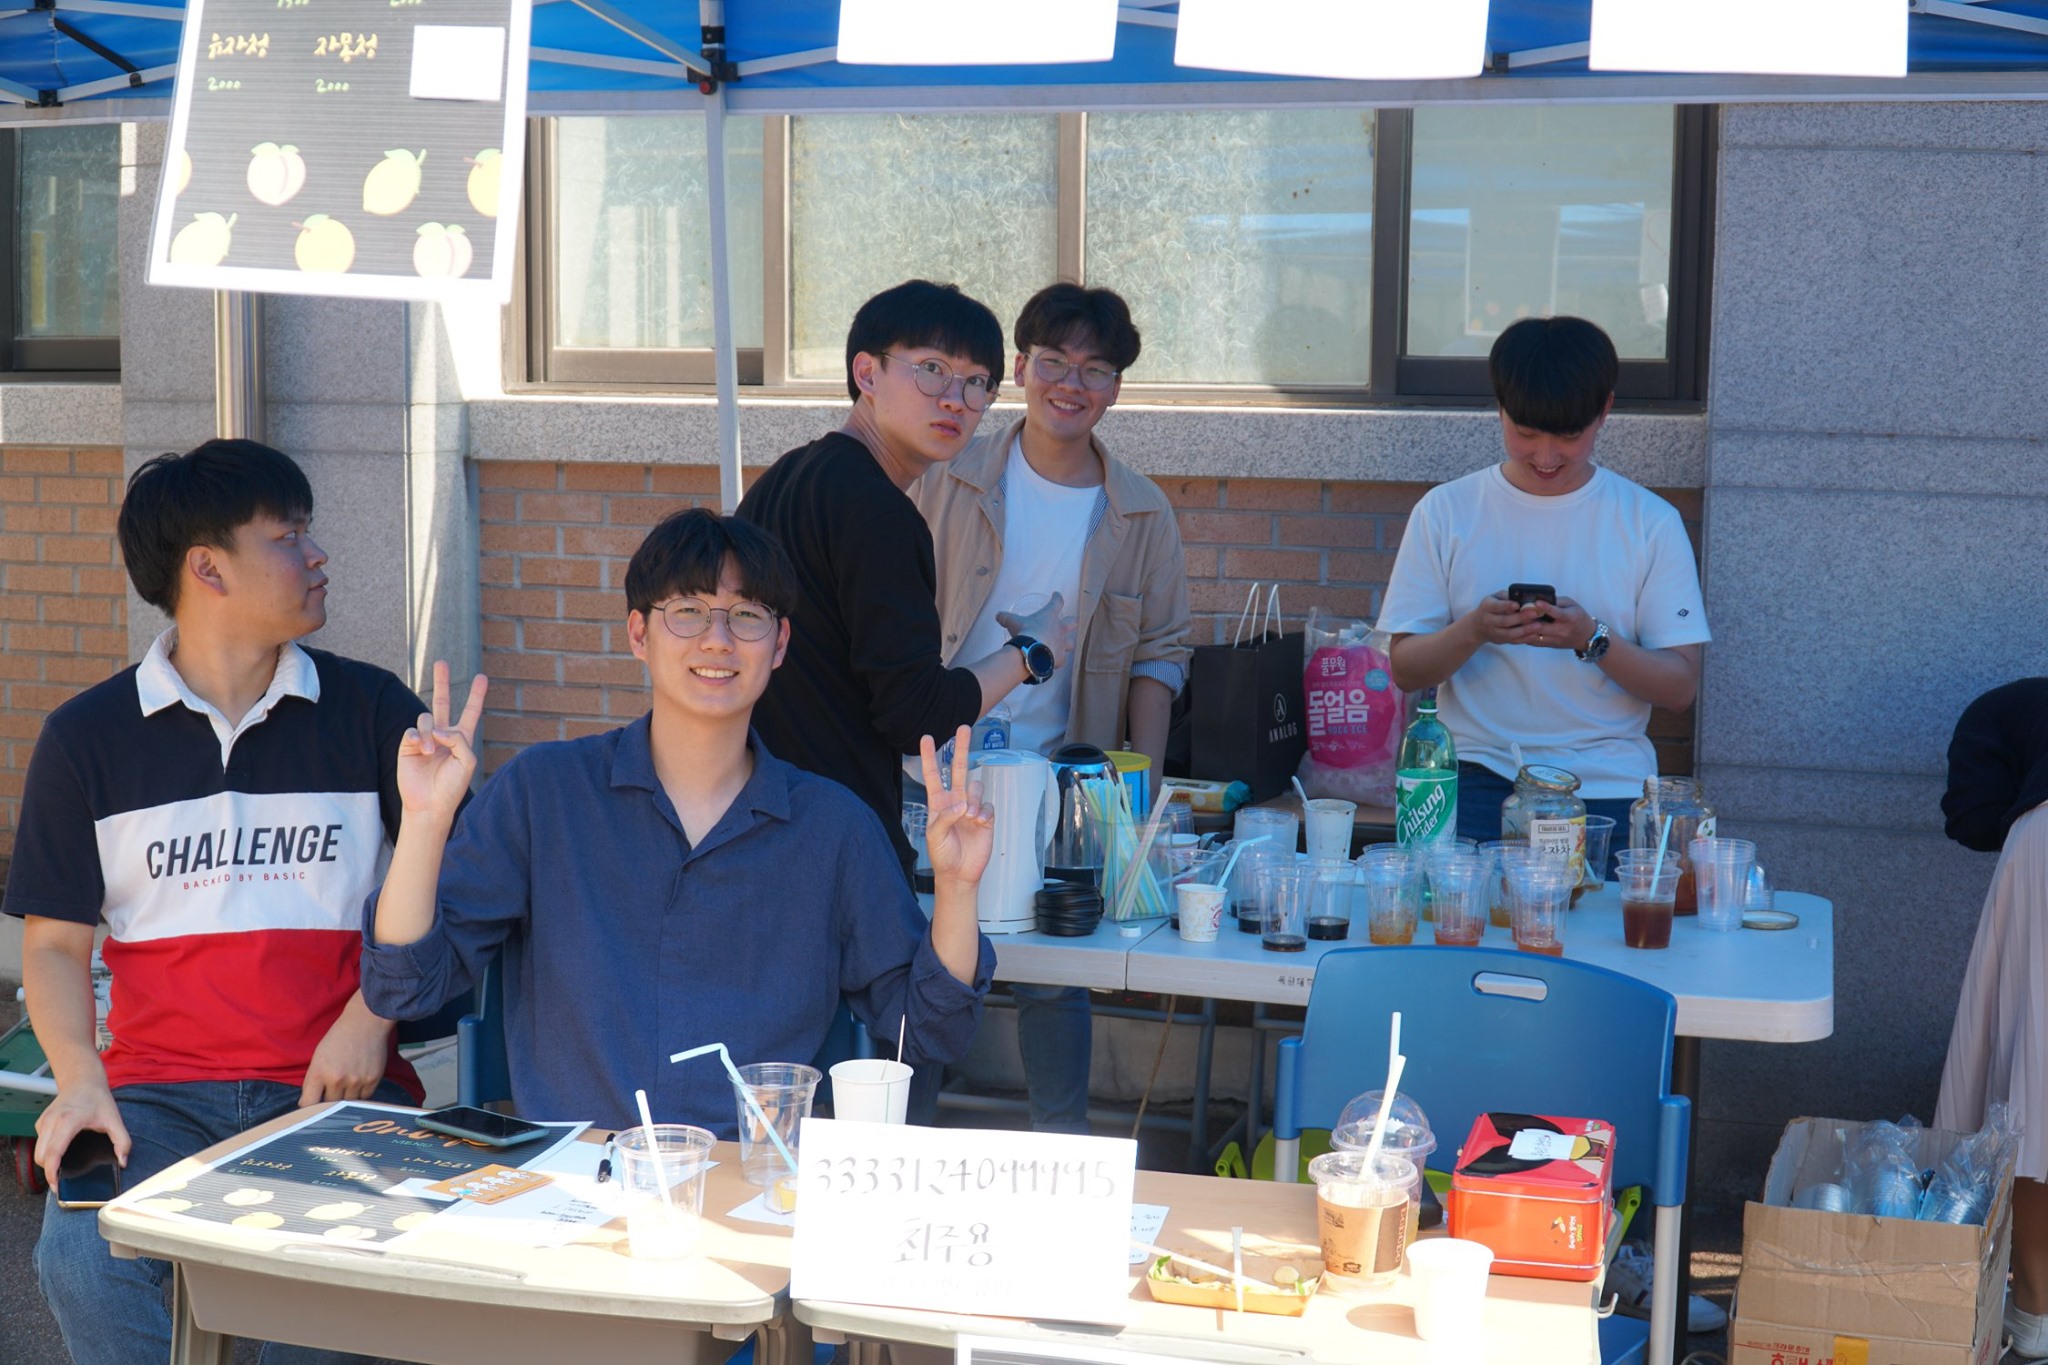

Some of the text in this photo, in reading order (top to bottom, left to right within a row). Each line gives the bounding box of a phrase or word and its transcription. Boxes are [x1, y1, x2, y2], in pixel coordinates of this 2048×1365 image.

[208, 32, 270, 60] 유자청
[313, 32, 379, 63] 자몽청
[207, 77, 241, 92] 2000
[315, 79, 350, 93] 2000
[1321, 655, 1347, 677] 풀무원
[1308, 688, 1370, 736] 돌얼음
[1269, 721, 1298, 743] ANALOG
[1397, 783, 1447, 848] Chilsung
[146, 824, 343, 880] CHALLENGE
[183, 871, 306, 890] BACKED BY BASIC
[391, 1138, 434, 1148] MENU
[893, 1216, 994, 1267] 최주용
